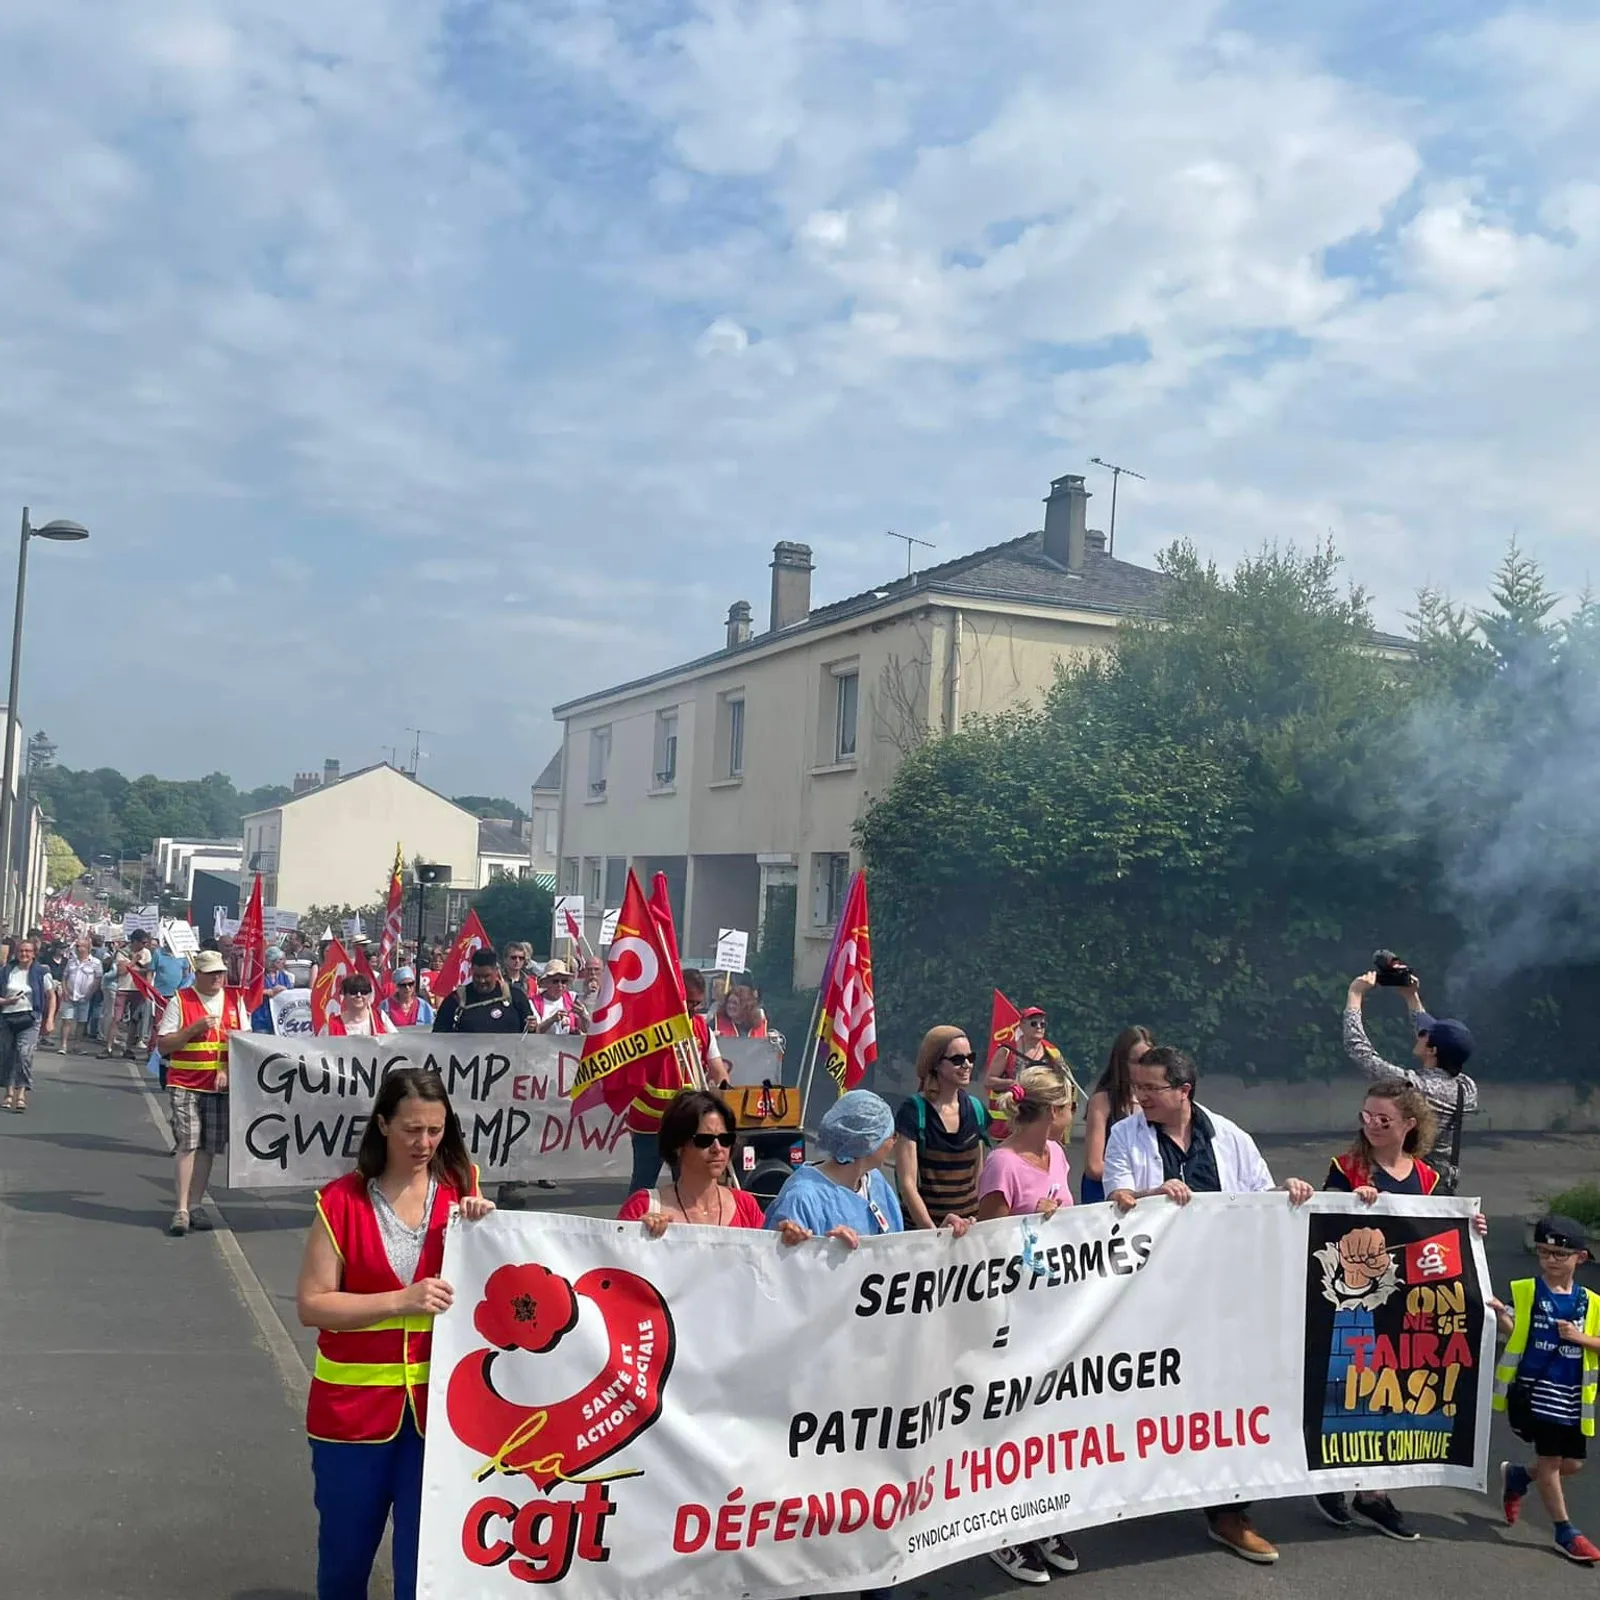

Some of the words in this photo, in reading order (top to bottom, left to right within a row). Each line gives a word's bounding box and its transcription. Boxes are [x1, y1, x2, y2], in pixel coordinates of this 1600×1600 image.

[512, 1074, 549, 1101] EN
[245, 1106, 531, 1170] GWEMP
[854, 1254, 1025, 1318] SERVICES
[1027, 1222, 1153, 1291] FERMÉS
[1416, 1242, 1449, 1277] cgt
[1402, 1311, 1435, 1333] NE
[1437, 1313, 1468, 1335] SE
[1405, 1280, 1467, 1318] ON
[576, 1399, 638, 1452] ACTION
[634, 1319, 655, 1400] SOCIALE
[581, 1370, 633, 1420] SANTÉ
[620, 1343, 634, 1366] ET
[1344, 1332, 1474, 1375] TAIRA
[787, 1384, 974, 1459] PATIENTS
[982, 1374, 1033, 1421] EN
[1033, 1347, 1182, 1407] DANGER
[1344, 1362, 1462, 1418] PAS!
[1321, 1432, 1341, 1465] LA
[1342, 1429, 1385, 1463] LUTTE
[1386, 1429, 1453, 1462] CONTINUE
[672, 1466, 936, 1555] DÉFENDONS
[943, 1423, 1125, 1501] L'HOPITAL
[1136, 1404, 1272, 1461] PUBLIC
[461, 1482, 617, 1583] cgt
[907, 1522, 962, 1555] SYNDICAT
[963, 1506, 1009, 1535] CGT-CH
[1010, 1491, 1073, 1524] GUINGAMP
